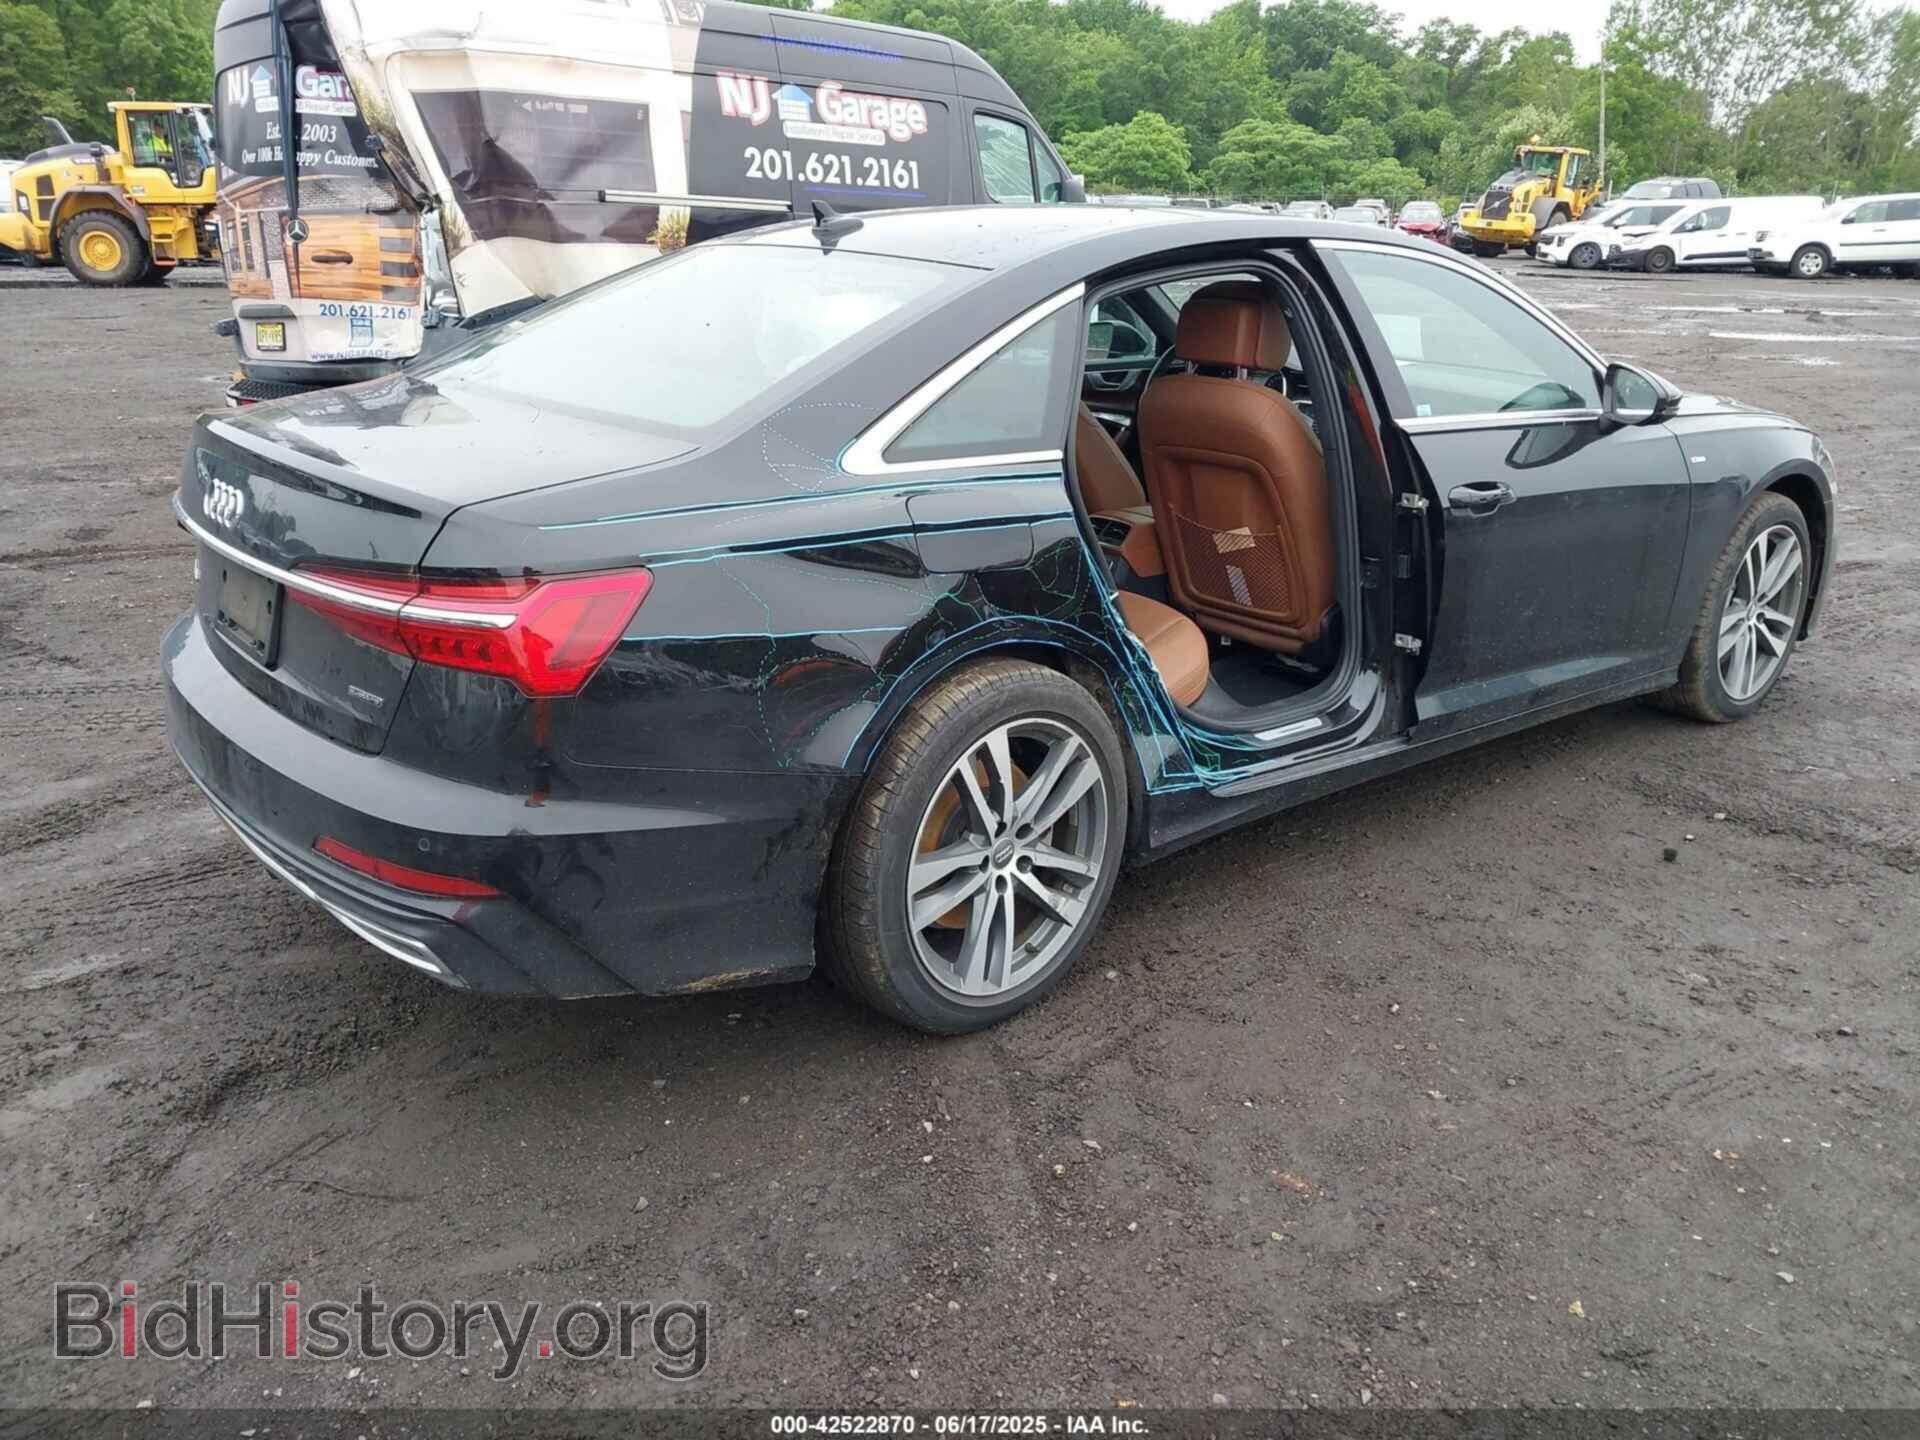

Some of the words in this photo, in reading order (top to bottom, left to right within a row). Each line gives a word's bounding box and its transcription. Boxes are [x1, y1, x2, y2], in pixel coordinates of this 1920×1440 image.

[226, 65, 249, 109] NJ
[716, 69, 771, 126] NJ
[816, 80, 928, 142] Garage
[302, 124, 337, 143] 2003
[744, 146, 919, 189] 201.621.2161
[319, 303, 412, 320] 201.621.2161
